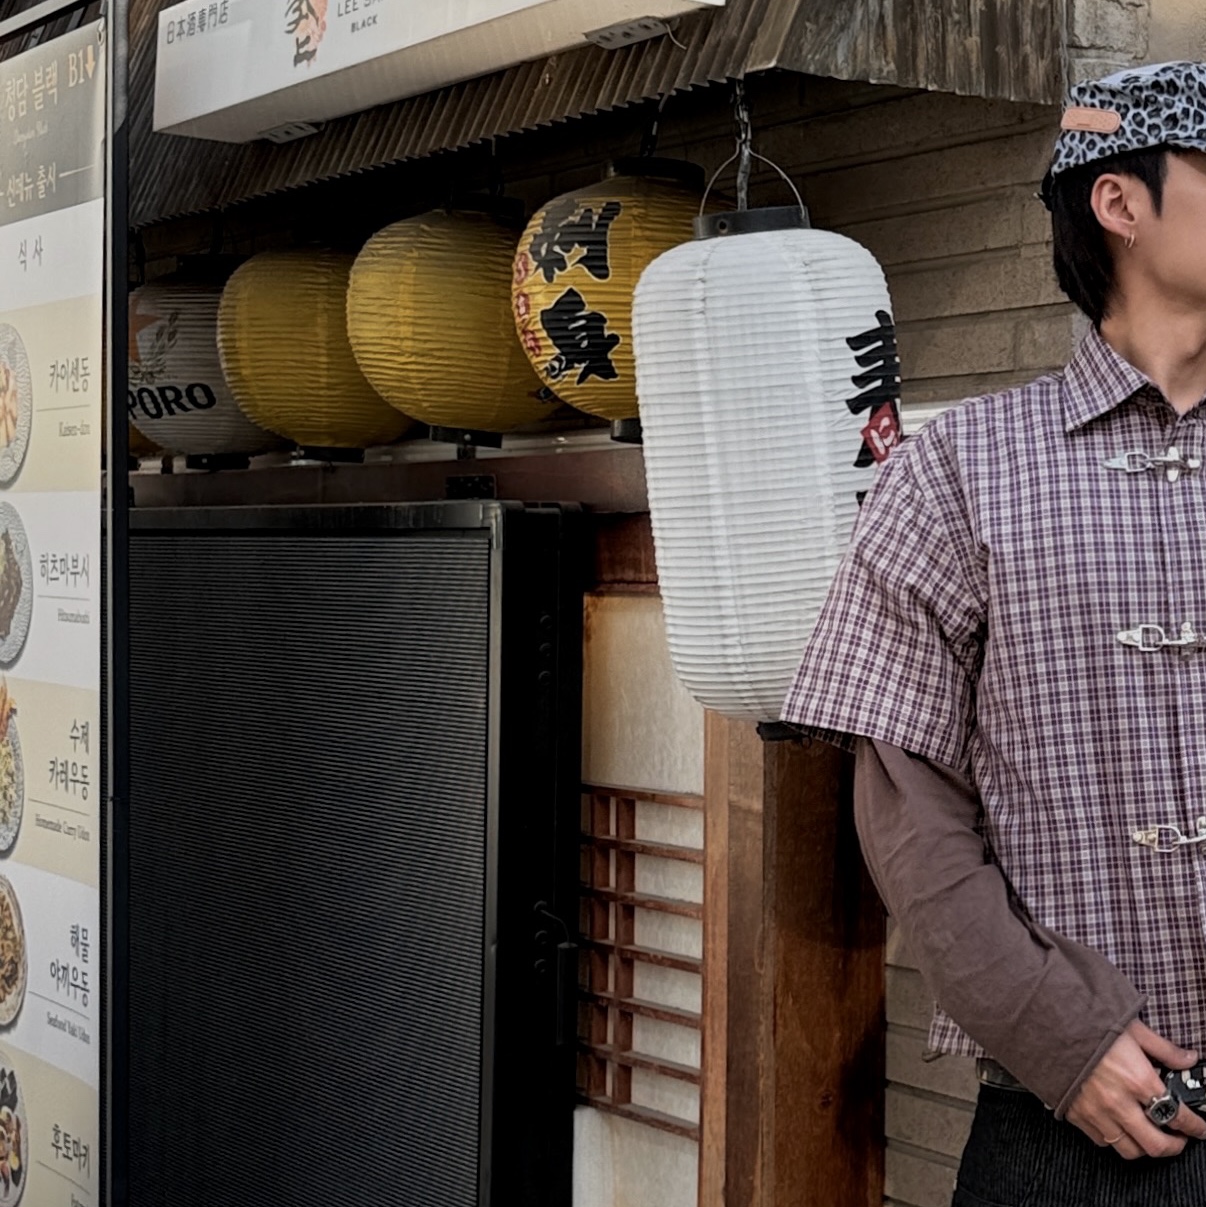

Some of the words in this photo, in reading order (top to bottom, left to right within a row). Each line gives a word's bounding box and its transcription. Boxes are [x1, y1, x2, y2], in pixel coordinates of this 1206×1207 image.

[351, 14, 378, 33] BLACK
[32, 60, 58, 111] 블랙
[68, 50, 85, 88] B1
[6, 172, 33, 208] 신메뉴
[36, 162, 57, 199] 출시
[49, 357, 91, 393] 카이센동
[39, 553, 90, 588] 히츠마부시
[69, 718, 90, 755] 수제
[49, 757, 90, 800] 카레우동
[70, 923, 90, 965] 해물
[50, 958, 90, 1008] 야끼우동
